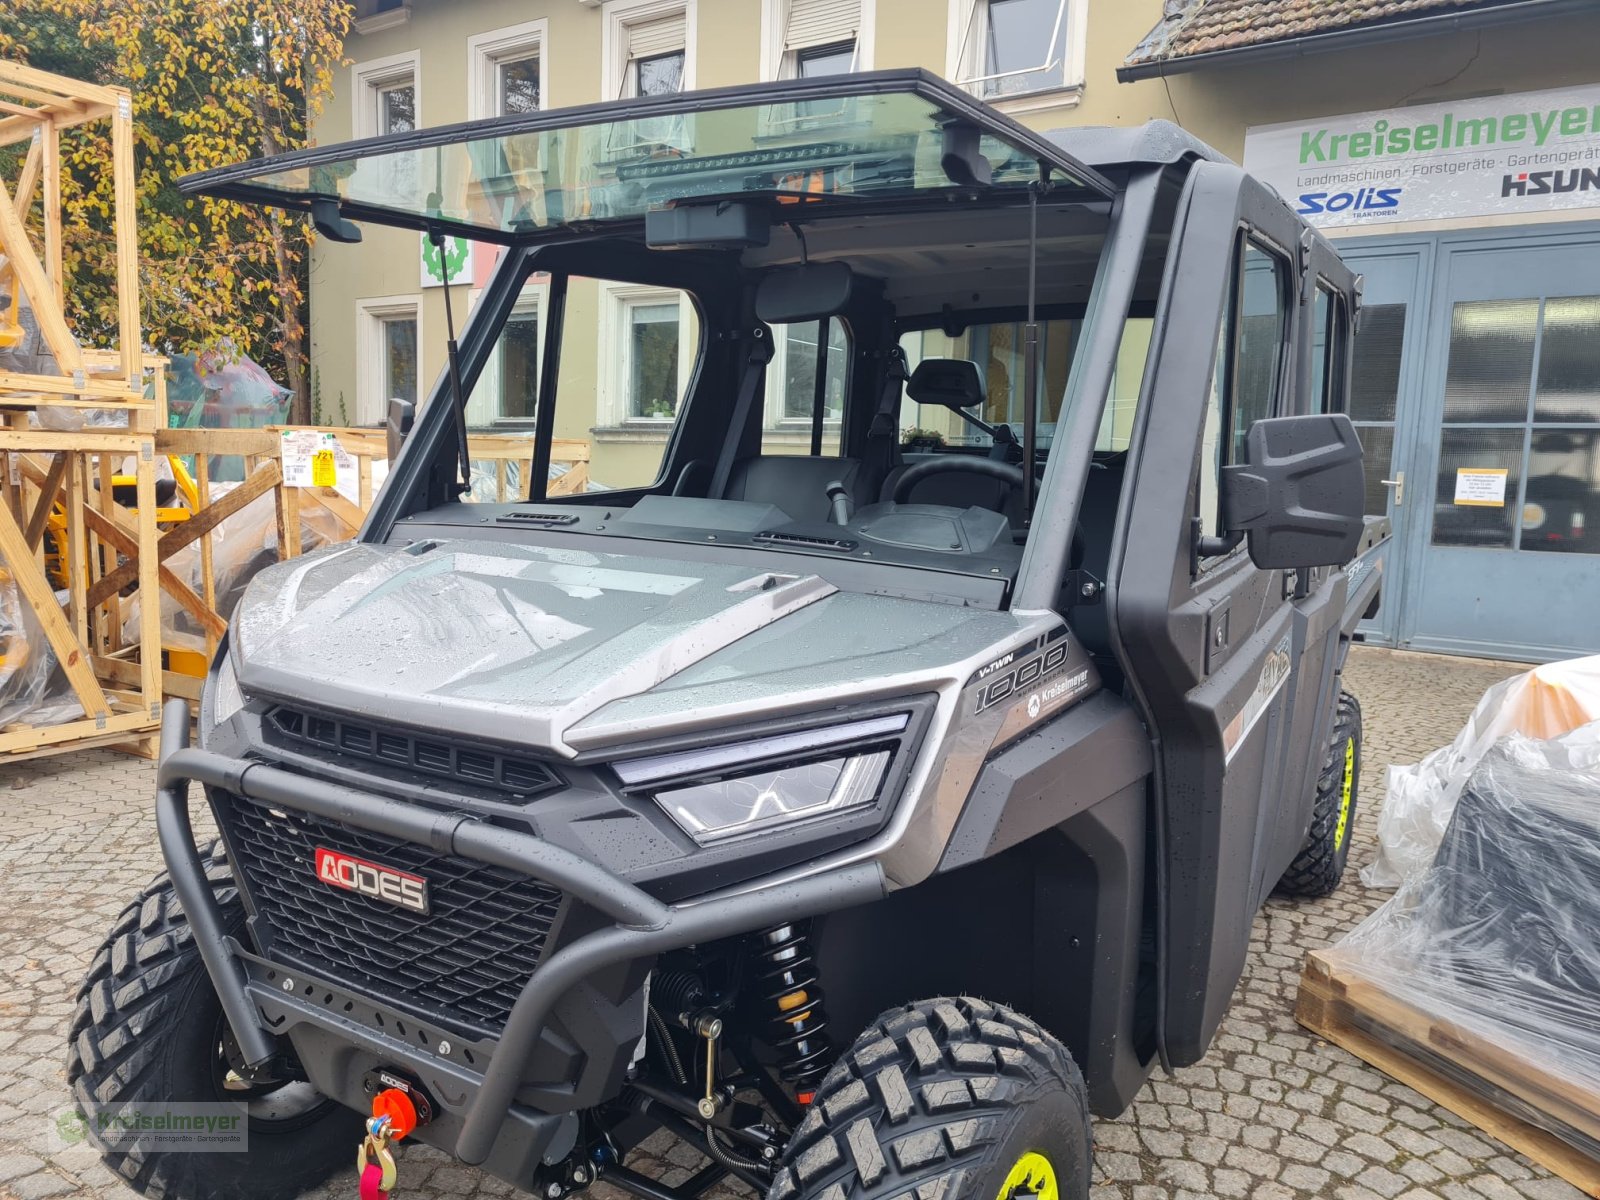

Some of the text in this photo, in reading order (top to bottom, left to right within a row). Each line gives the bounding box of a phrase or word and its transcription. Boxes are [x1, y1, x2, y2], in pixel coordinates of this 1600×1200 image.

[1296, 168, 1400, 188] Landmaschinen
[1412, 159, 1495, 176] Forstgeräte
[1353, 209, 1398, 219] TRAKTOREN
[974, 639, 1069, 715] 1000
[979, 652, 1014, 679] V-TWIN
[1041, 669, 1088, 702] Kreiselmeyer
[321, 854, 424, 910] AODES
